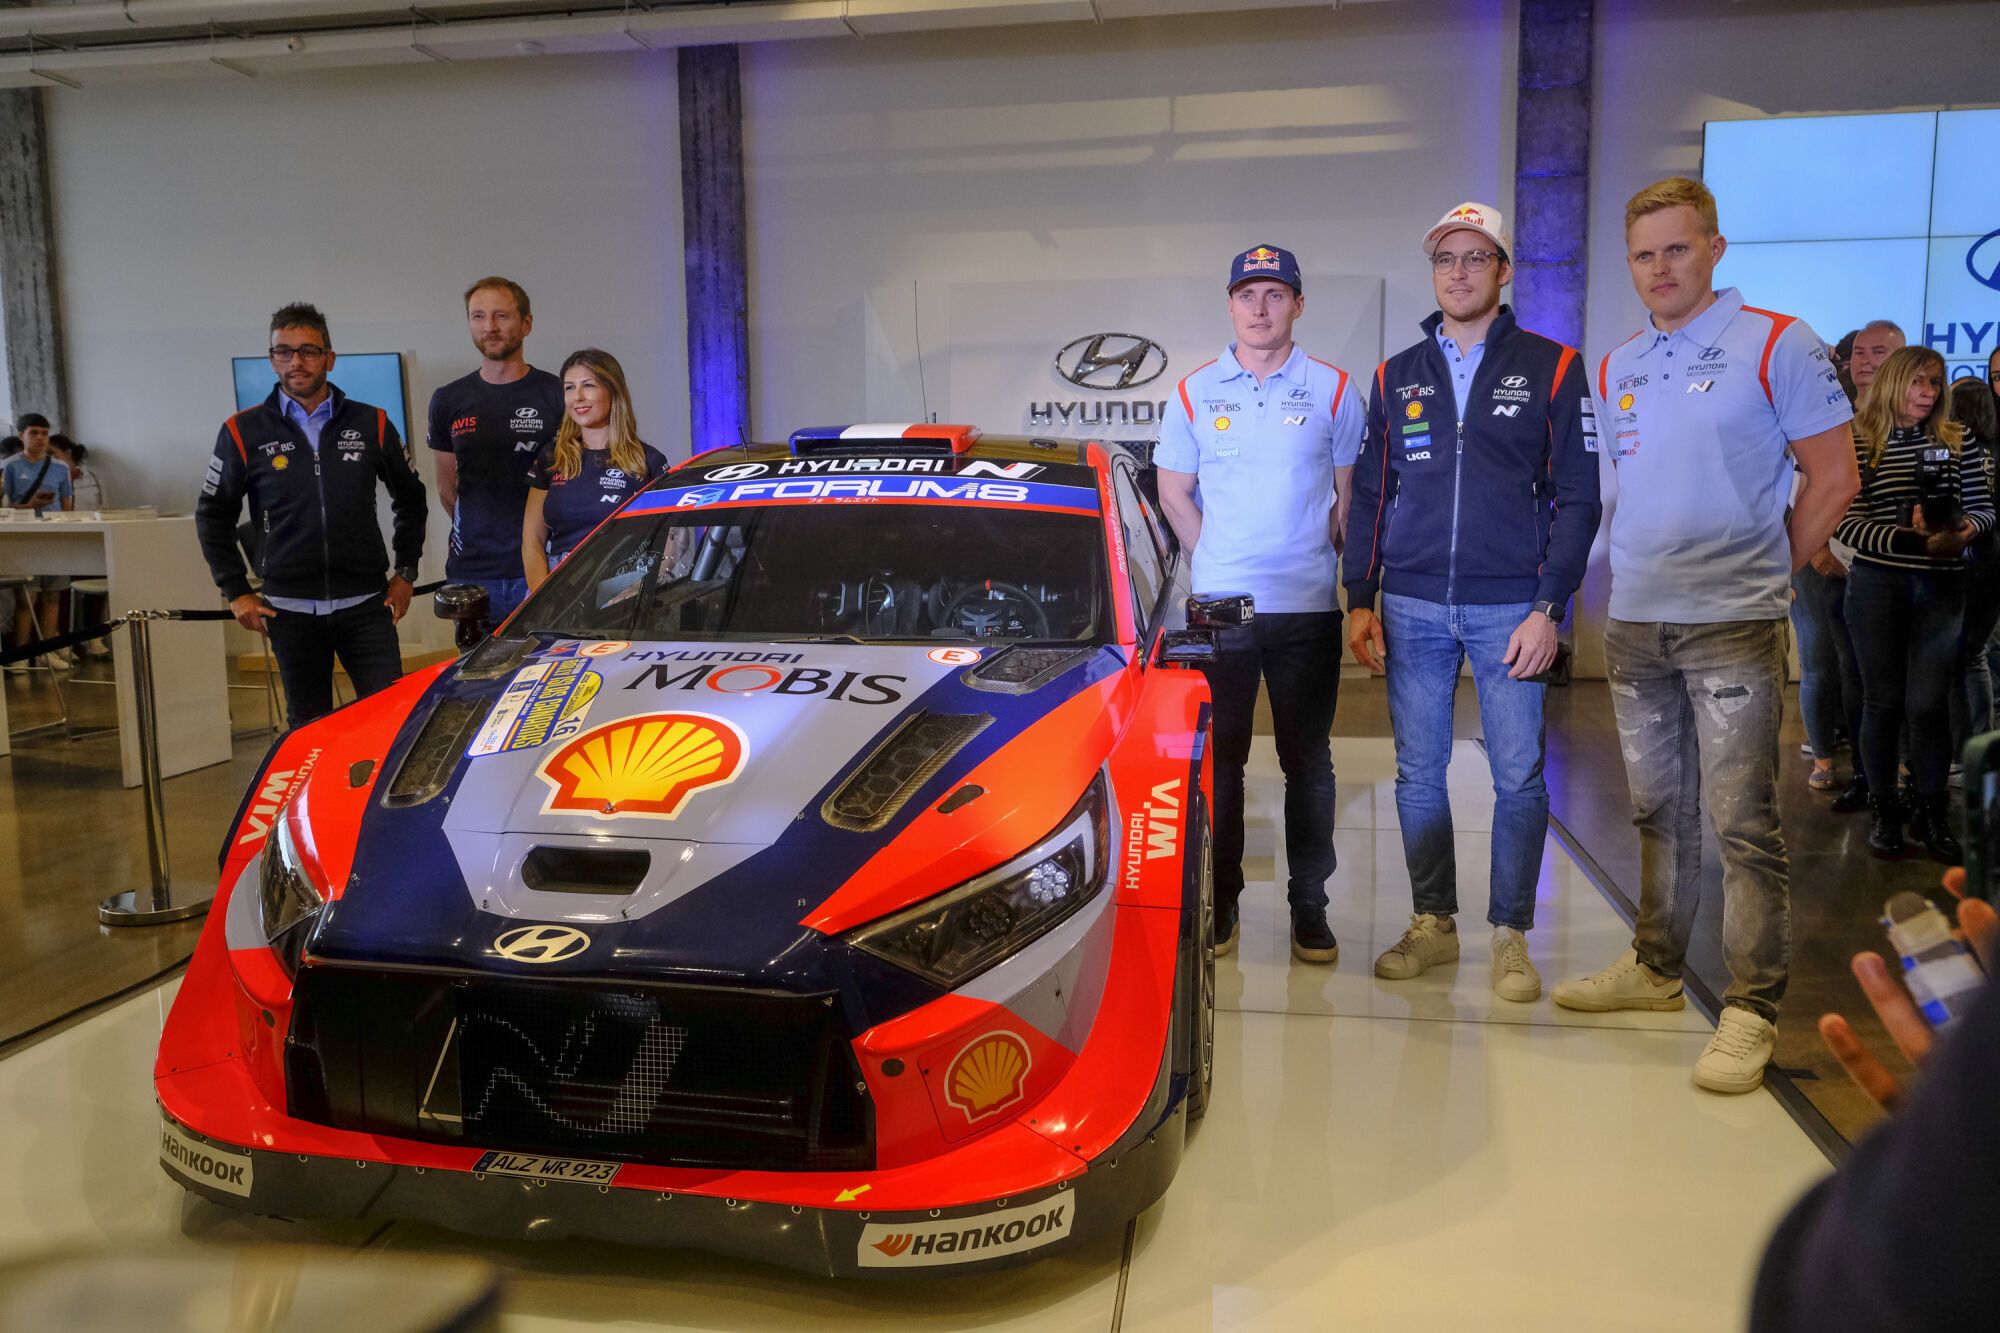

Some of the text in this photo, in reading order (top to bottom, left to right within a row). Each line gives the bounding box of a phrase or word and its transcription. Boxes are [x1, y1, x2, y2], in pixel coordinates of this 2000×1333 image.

[1243, 261, 1280, 272] Red Bull
[1925, 322, 2000, 354] HY
[1688, 363, 1728, 372] HYUNDAI
[1617, 375, 1649, 392] MOBIS
[1402, 385, 1435, 400] MOBIS
[1492, 395, 1529, 403] MOTORSPORT
[1493, 389, 1530, 397] HYUNDAI
[1209, 403, 1241, 414] MOBIS
[451, 416, 477, 430] AVIS
[1406, 451, 1432, 462] LKQ
[778, 458, 945, 475] HYUNDAI
[729, 480, 1029, 502] FORUM8
[620, 650, 805, 664] HYUNDAI
[940, 650, 965, 661] E
[623, 663, 907, 705] MOBIS
[512, 698, 563, 749] CANARIAS
[1125, 812, 1145, 889] HYUNDAI
[491, 1155, 615, 1179] ALZ WR 923
